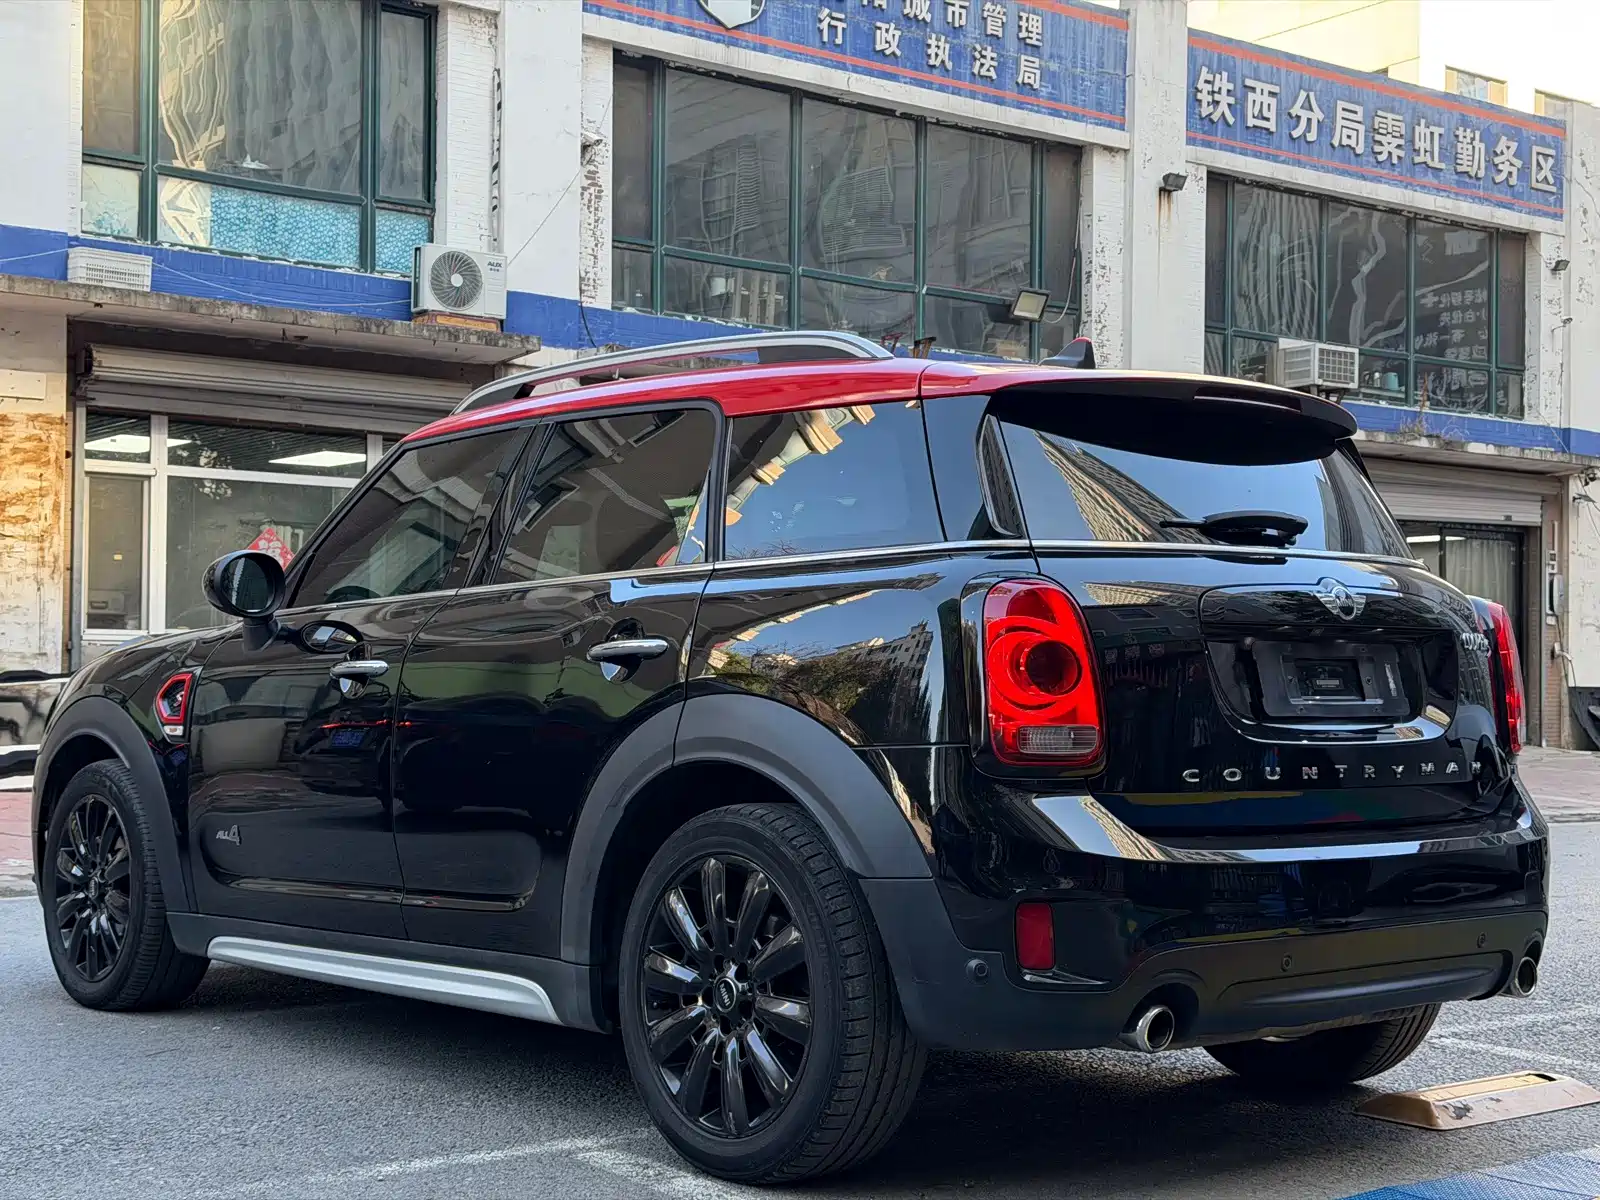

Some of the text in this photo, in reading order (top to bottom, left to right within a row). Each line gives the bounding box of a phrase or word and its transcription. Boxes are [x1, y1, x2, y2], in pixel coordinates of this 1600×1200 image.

[817, 8, 1042, 89] 行政执法局
[1195, 66, 1558, 193] 铁西分局霁虹勤务区
[1182, 760, 1482, 782] COUNTRYMAN
[719, 982, 731, 1007] MINI
